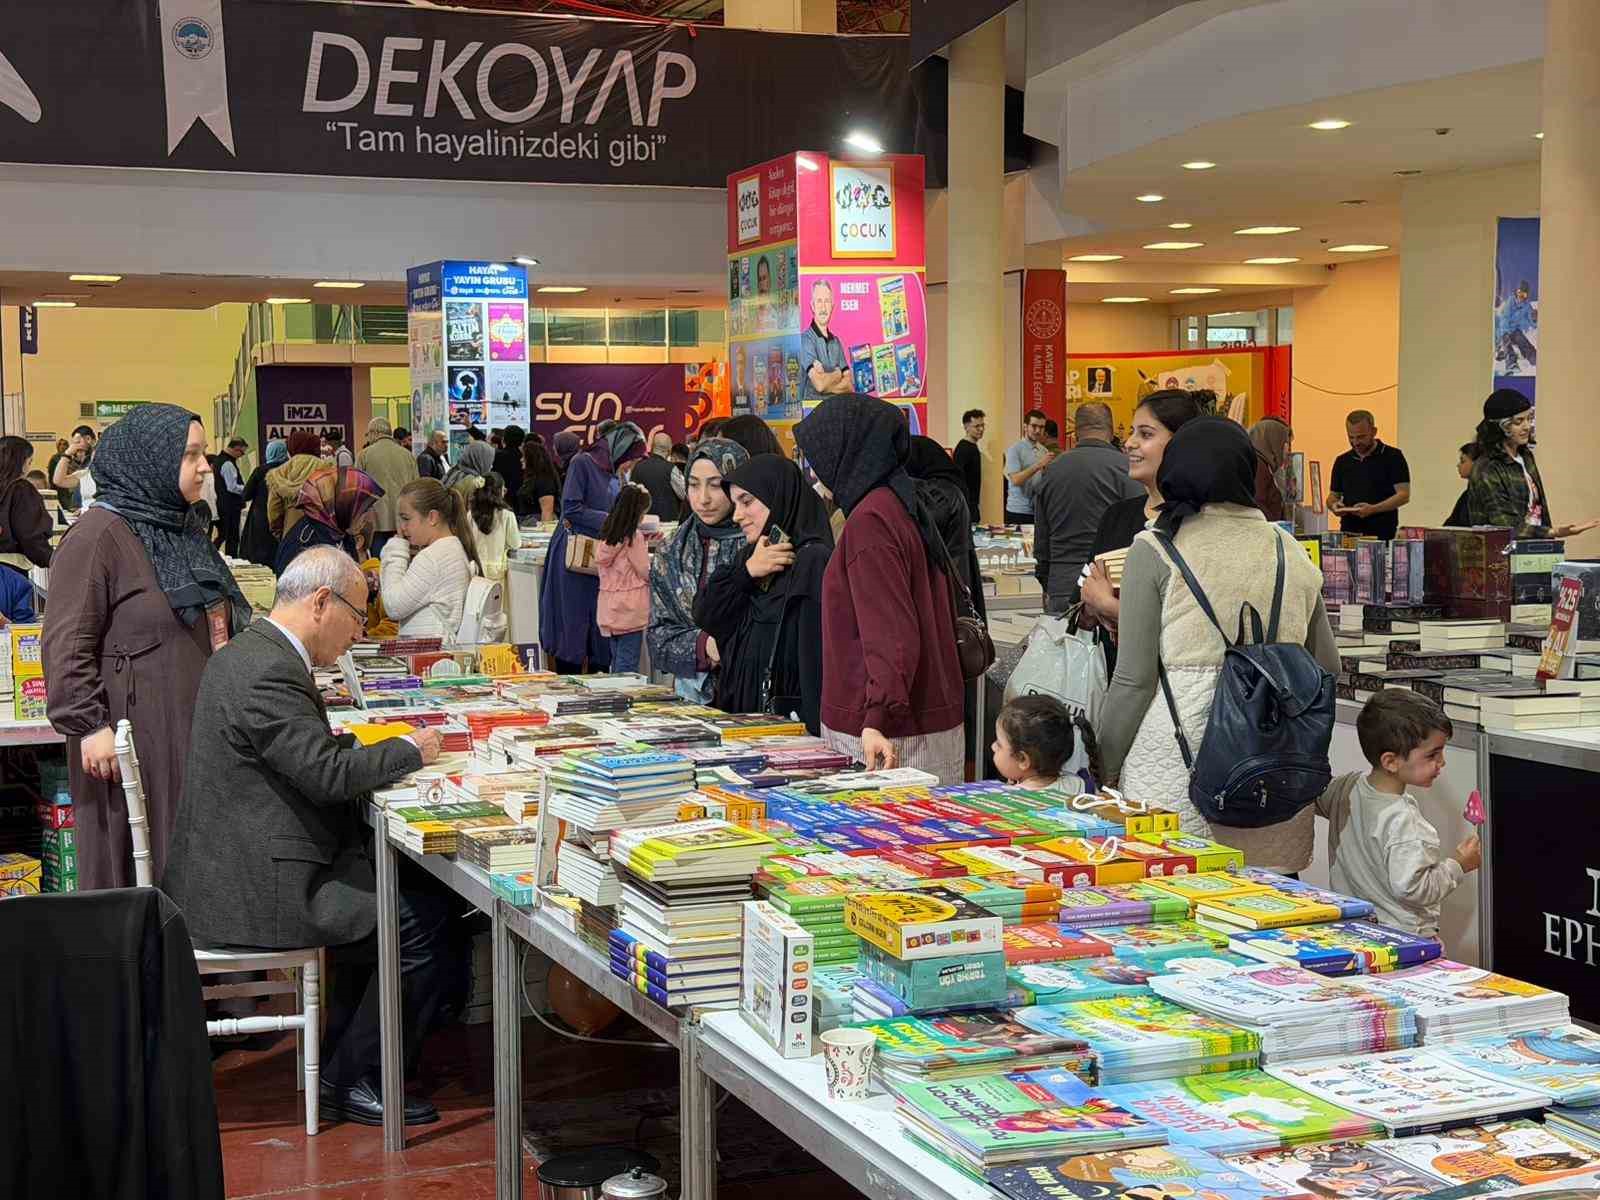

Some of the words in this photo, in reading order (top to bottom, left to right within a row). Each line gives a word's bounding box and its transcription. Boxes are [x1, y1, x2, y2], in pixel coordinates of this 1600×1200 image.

[303, 31, 697, 128] DEKOYAP
[415, 125, 600, 162] hayalinizdeki
[841, 223, 887, 242] ÇOCUK
[453, 275, 483, 286] YAYIN
[483, 275, 516, 286] GRUBU
[287, 405, 325, 419] İMZA
